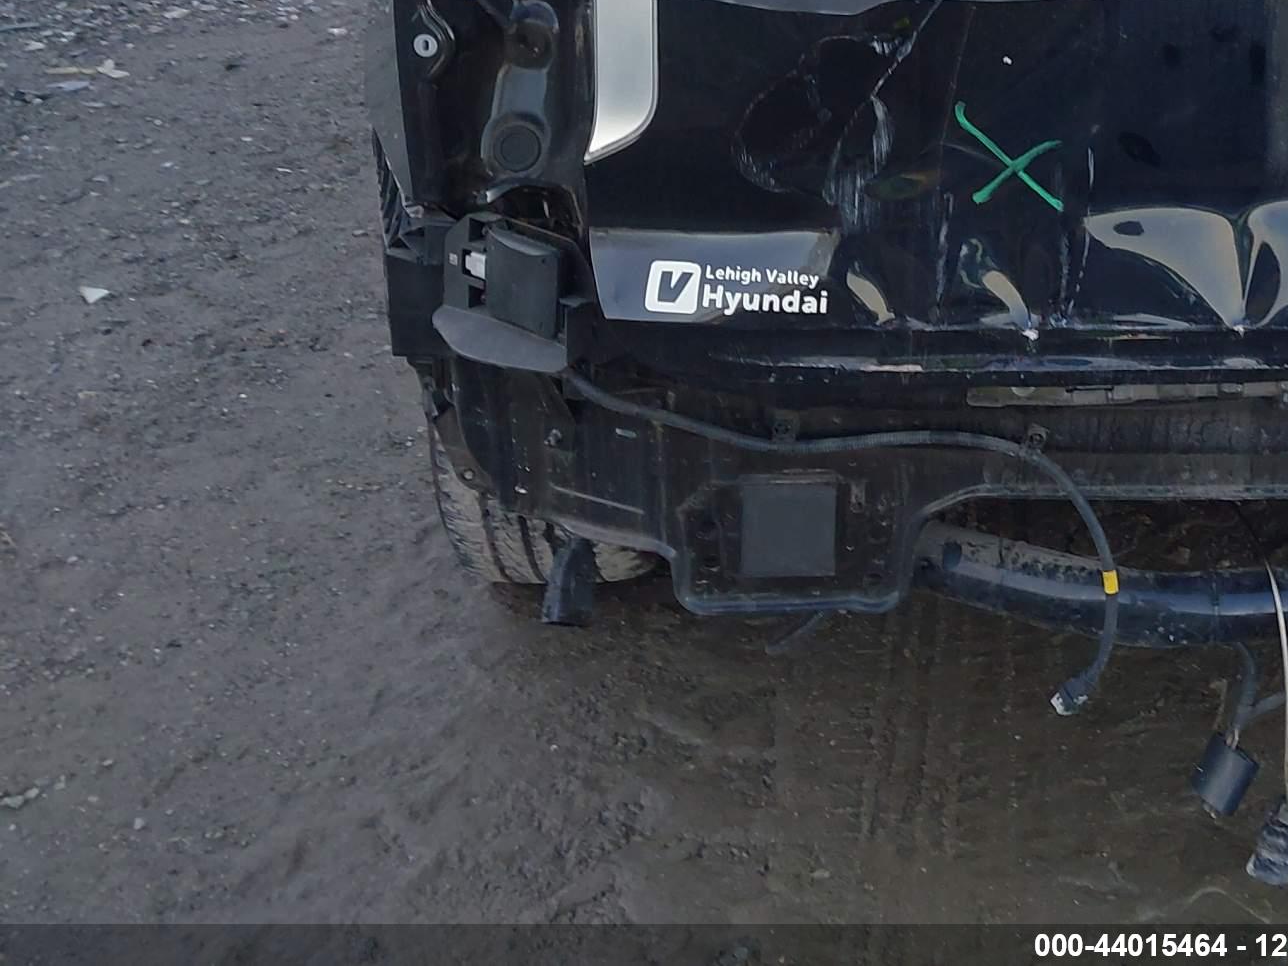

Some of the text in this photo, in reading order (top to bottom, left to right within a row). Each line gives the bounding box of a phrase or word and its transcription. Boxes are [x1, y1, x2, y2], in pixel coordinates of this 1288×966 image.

[705, 265, 761, 284] Lehigh
[766, 269, 819, 289] Valley
[702, 284, 828, 315] Hyundai
